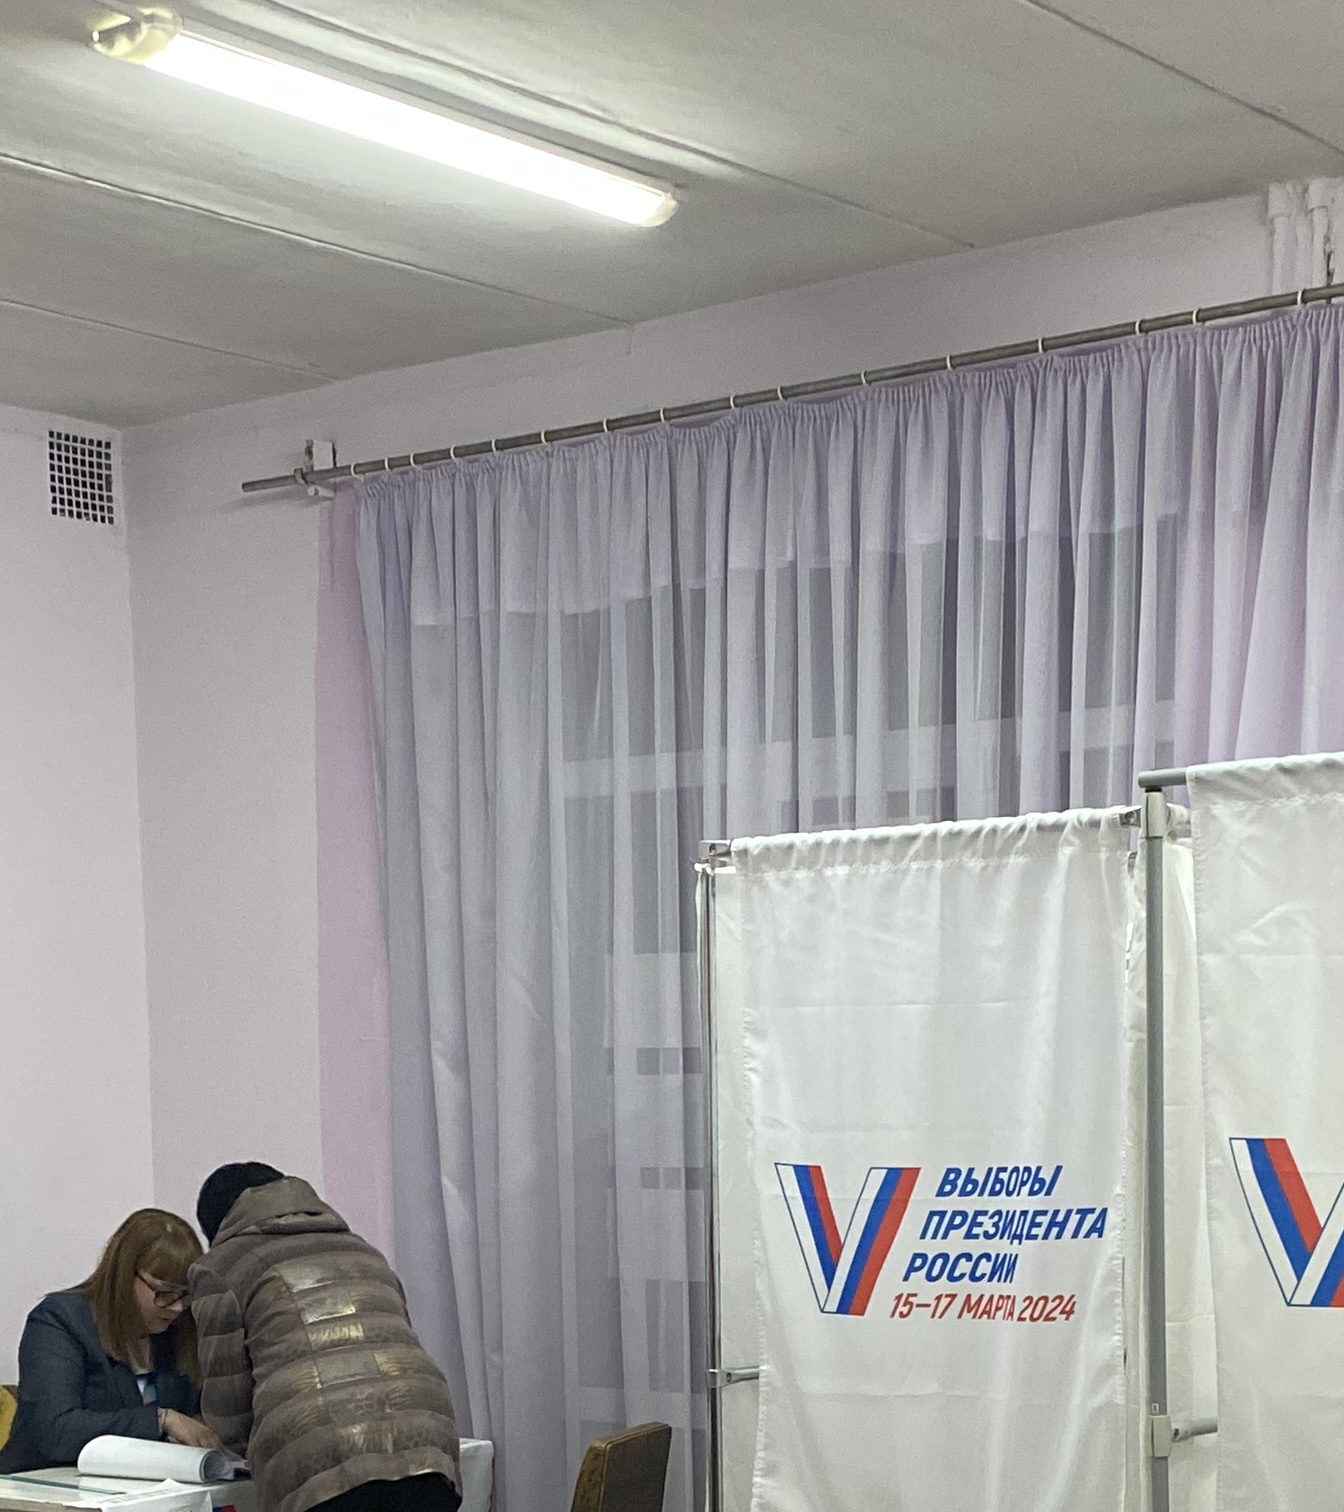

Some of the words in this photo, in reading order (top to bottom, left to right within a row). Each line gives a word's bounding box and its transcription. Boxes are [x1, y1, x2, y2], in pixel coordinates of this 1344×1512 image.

[935, 1164, 1063, 1198] ВЫБОРЫ
[919, 1206, 1109, 1246] ПРЕЗИДЕНТА
[902, 1251, 1019, 1285] РОССИИ
[957, 1293, 1016, 1322] МАРТА
[1017, 1294, 1077, 1323] 2024
